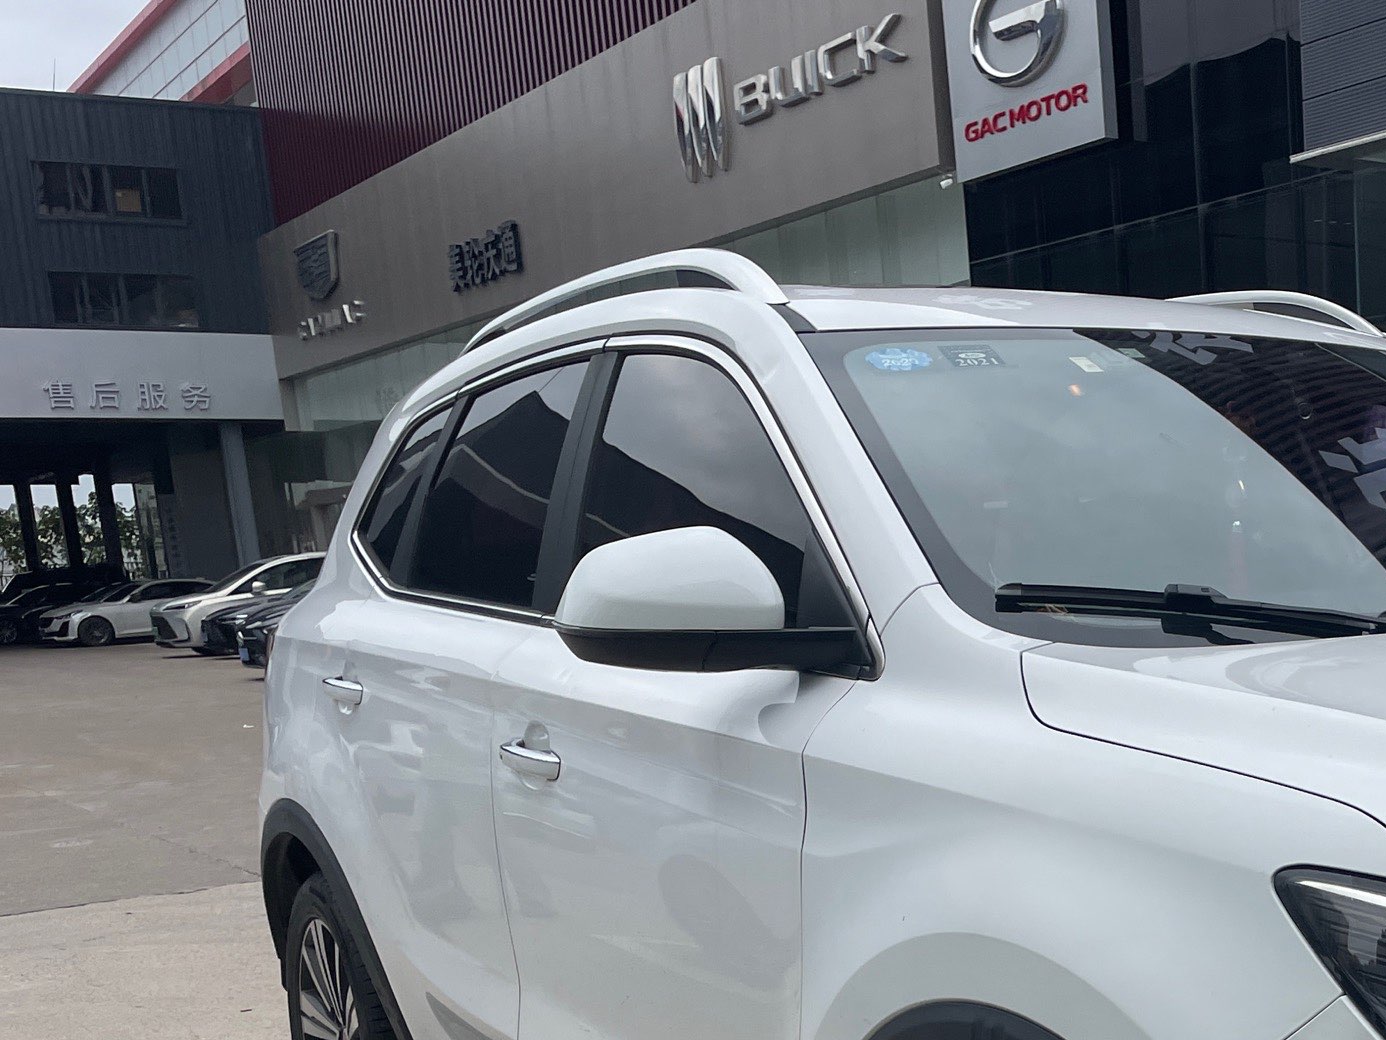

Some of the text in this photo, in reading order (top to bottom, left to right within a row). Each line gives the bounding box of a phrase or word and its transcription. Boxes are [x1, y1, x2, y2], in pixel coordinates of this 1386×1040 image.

[733, 13, 908, 126] BUICK
[964, 83, 1089, 143] GAC MOTOR
[43, 377, 211, 411] 售后服务
